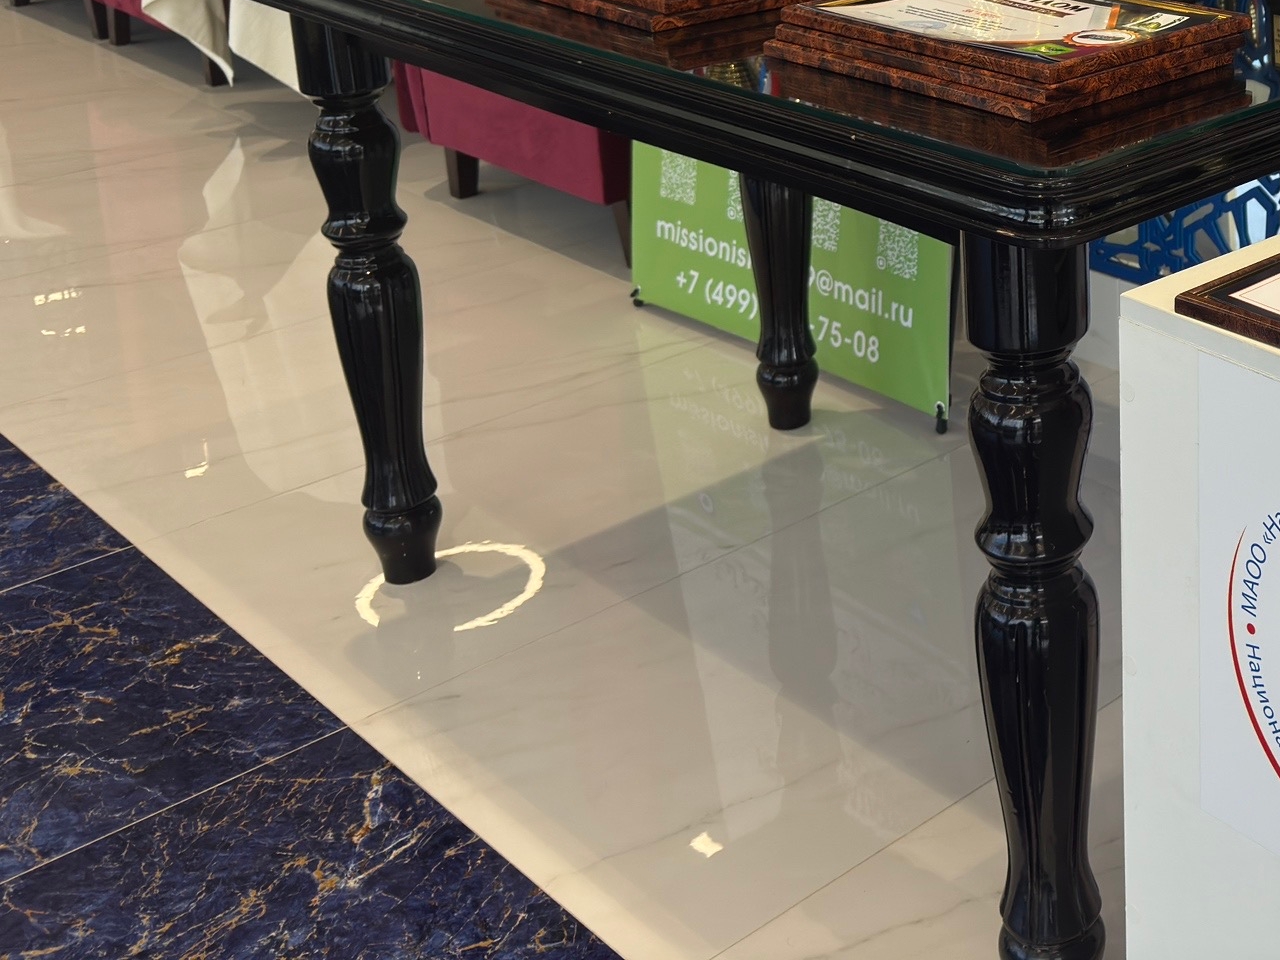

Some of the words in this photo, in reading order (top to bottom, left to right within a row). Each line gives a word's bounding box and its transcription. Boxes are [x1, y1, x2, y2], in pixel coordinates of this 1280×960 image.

[676, 270, 699, 295] +7
[705, 277, 758, 321] (499)
[1240, 542, 1268, 618] МАОО
